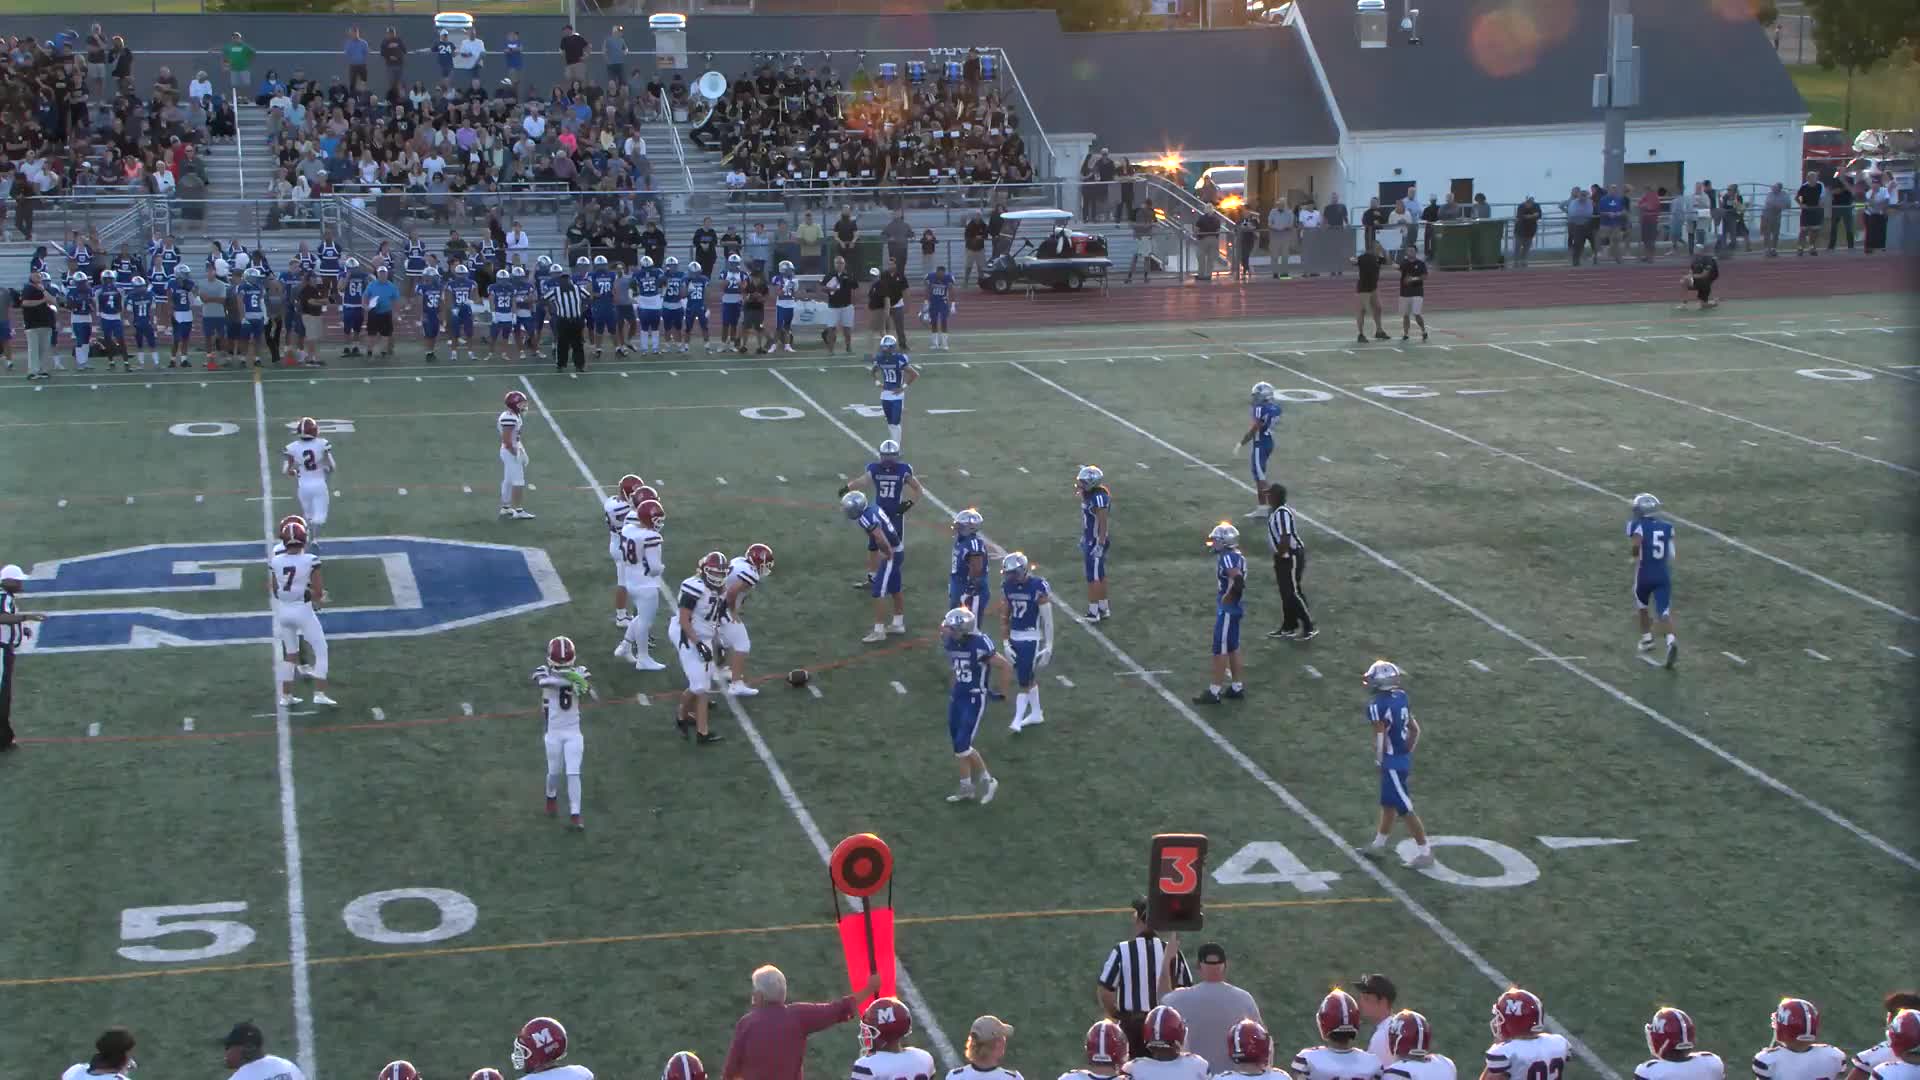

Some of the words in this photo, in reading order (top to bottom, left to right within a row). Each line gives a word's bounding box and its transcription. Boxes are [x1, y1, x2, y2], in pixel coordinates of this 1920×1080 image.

[438, 44, 453, 54] 24
[497, 296, 510, 308] 23
[883, 368, 897, 383] 10
[302, 449, 316, 470] 2
[879, 480, 896, 498] 51
[1652, 530, 1665, 560] 5
[282, 565, 297, 592] 7
[1011, 600, 1028, 619] 17
[559, 686, 572, 711] 6
[1159, 846, 1199, 895] 3
[877, 1006, 897, 1025] M
[1504, 999, 1524, 1016] M
[531, 1027, 554, 1049] M
